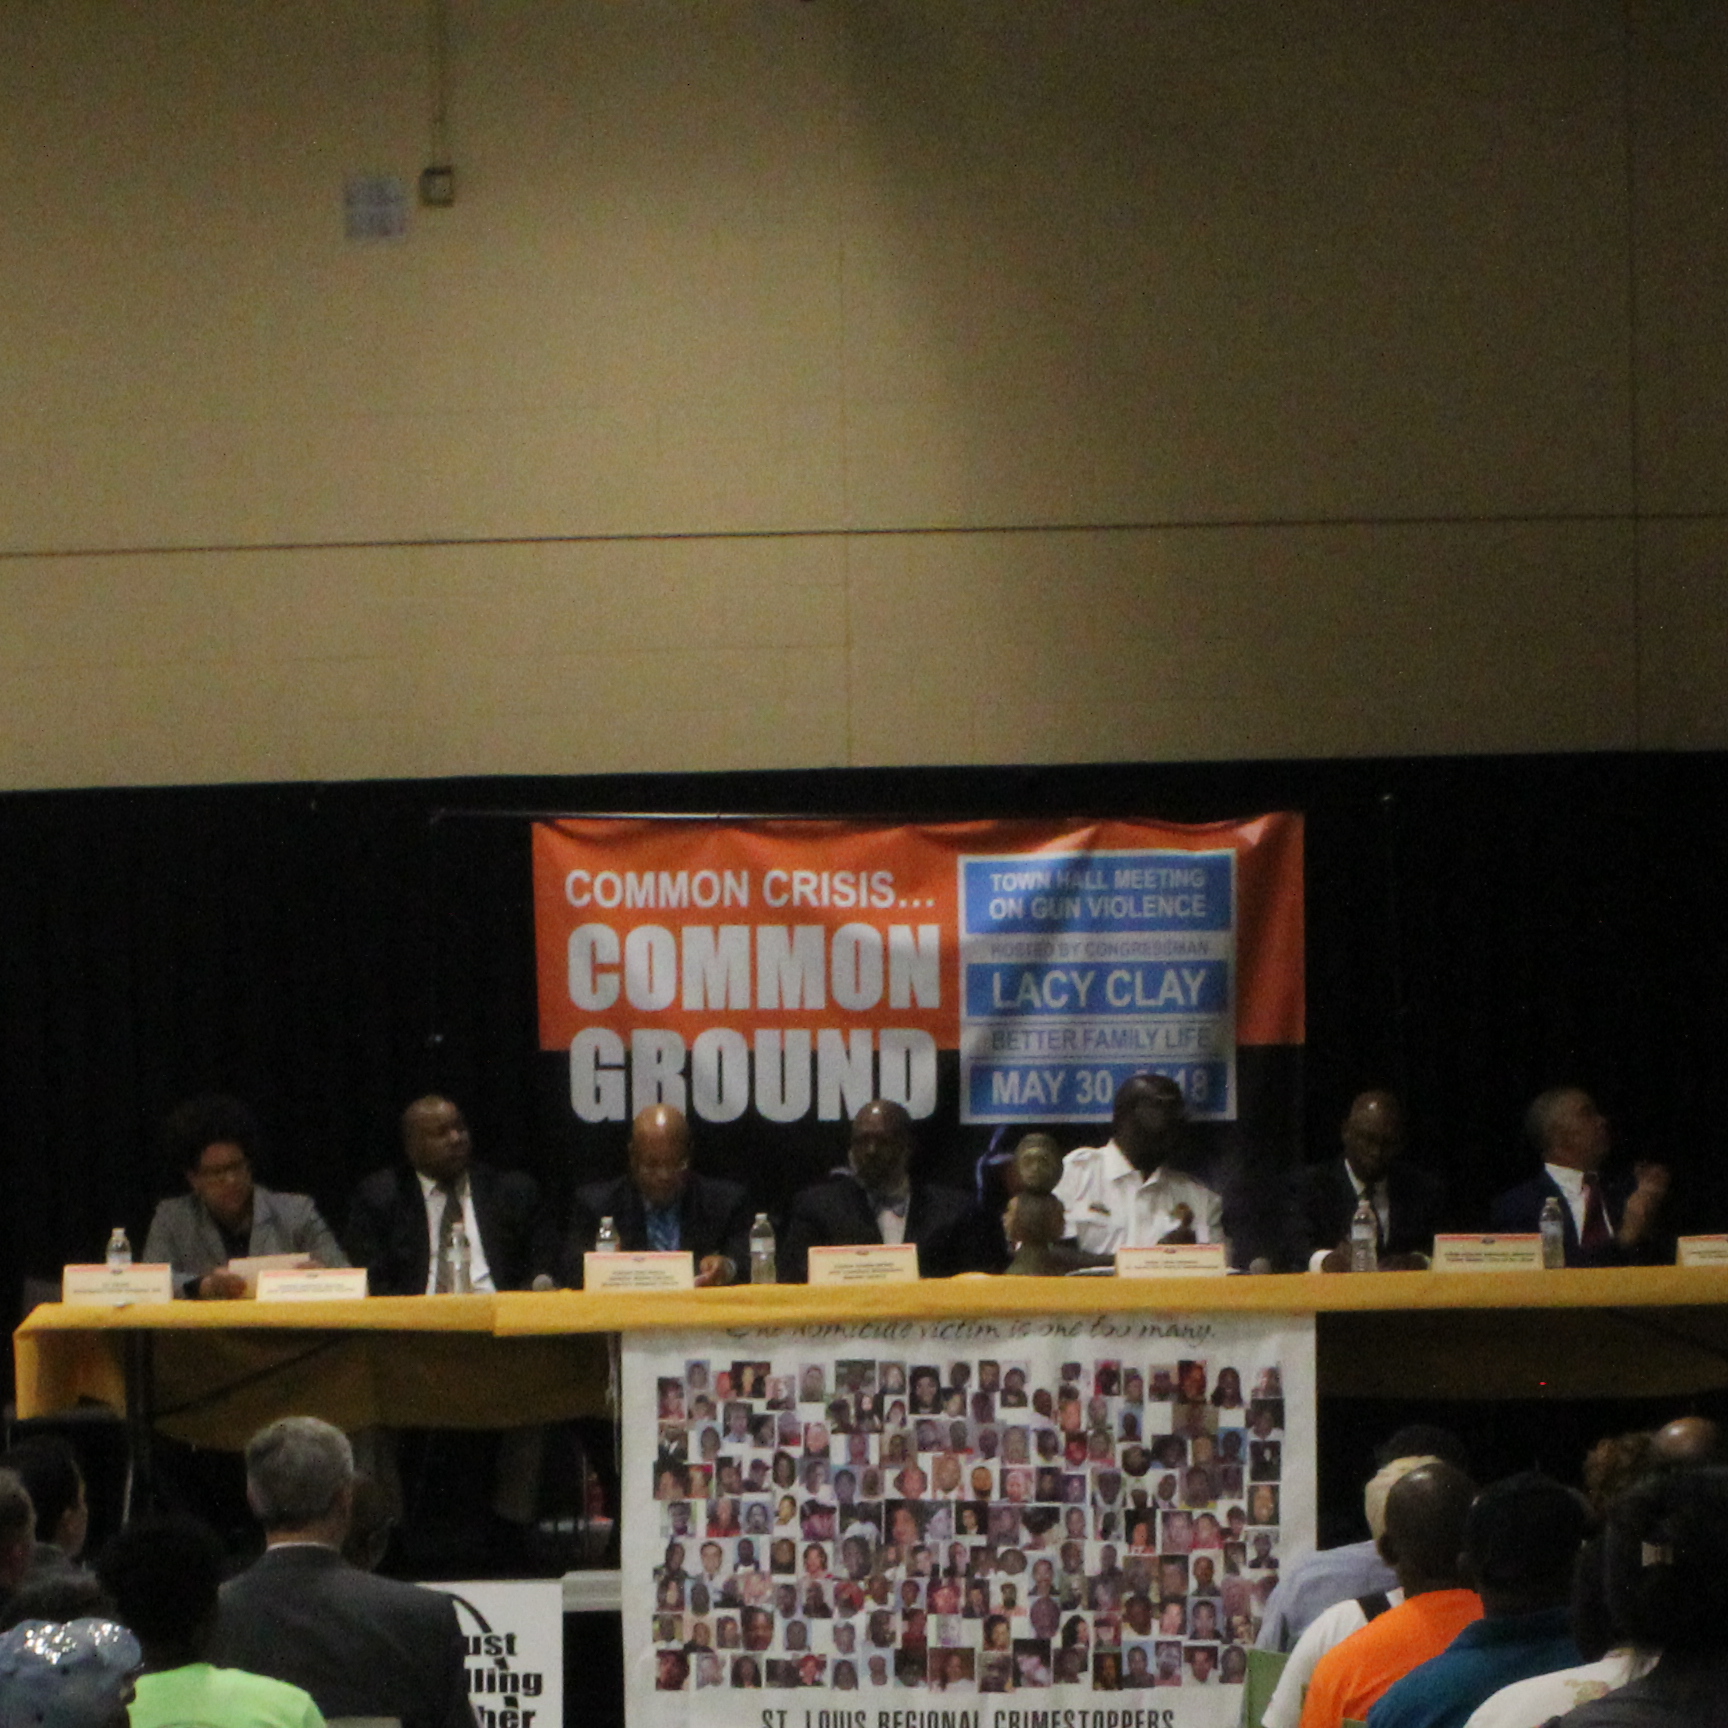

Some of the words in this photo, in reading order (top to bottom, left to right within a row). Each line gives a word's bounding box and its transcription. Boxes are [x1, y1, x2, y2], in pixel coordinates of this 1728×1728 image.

[565, 869, 749, 909] COMMON
[763, 869, 936, 909] CRISIS...
[989, 871, 1051, 892] TOWN
[1056, 870, 1108, 890] HALL
[1114, 867, 1206, 889] MEETING
[989, 898, 1023, 920] ON
[1032, 896, 1080, 919] GUN
[1088, 894, 1207, 918] VIOLENCE
[1060, 942, 1081, 957] BY
[1086, 940, 1209, 956] CONGRESSMAN
[567, 923, 940, 1012] COMMON
[992, 970, 1095, 1008] LACY
[1105, 968, 1207, 1007] CLAY
[992, 1030, 1077, 1051] BETTER
[1083, 1029, 1159, 1050] FAMILY
[1167, 1028, 1209, 1049] LIFE
[569, 1027, 937, 1123] GROUND
[992, 1070, 1066, 1105] MAY
[1075, 1069, 1113, 1104] 30
[1135, 1068, 1209, 1103] 18
[1041, 1319, 1082, 1338] one
[1090, 1315, 1132, 1339] too
